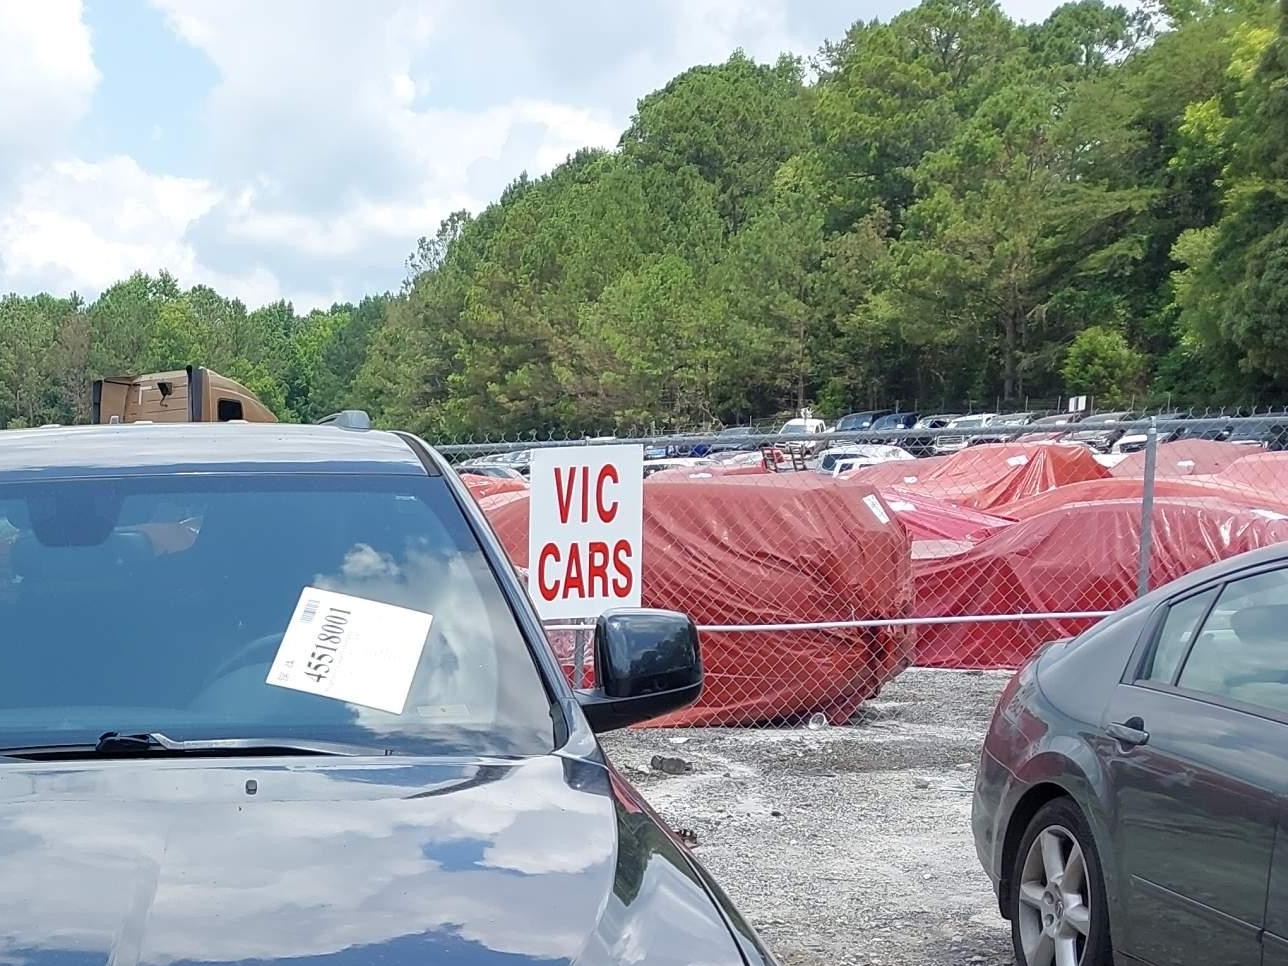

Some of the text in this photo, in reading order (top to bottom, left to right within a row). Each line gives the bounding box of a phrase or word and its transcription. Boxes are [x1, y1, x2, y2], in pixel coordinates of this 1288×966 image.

[553, 464, 619, 523] VIC
[538, 539, 633, 601] CARS
[303, 607, 351, 683] 45518001
